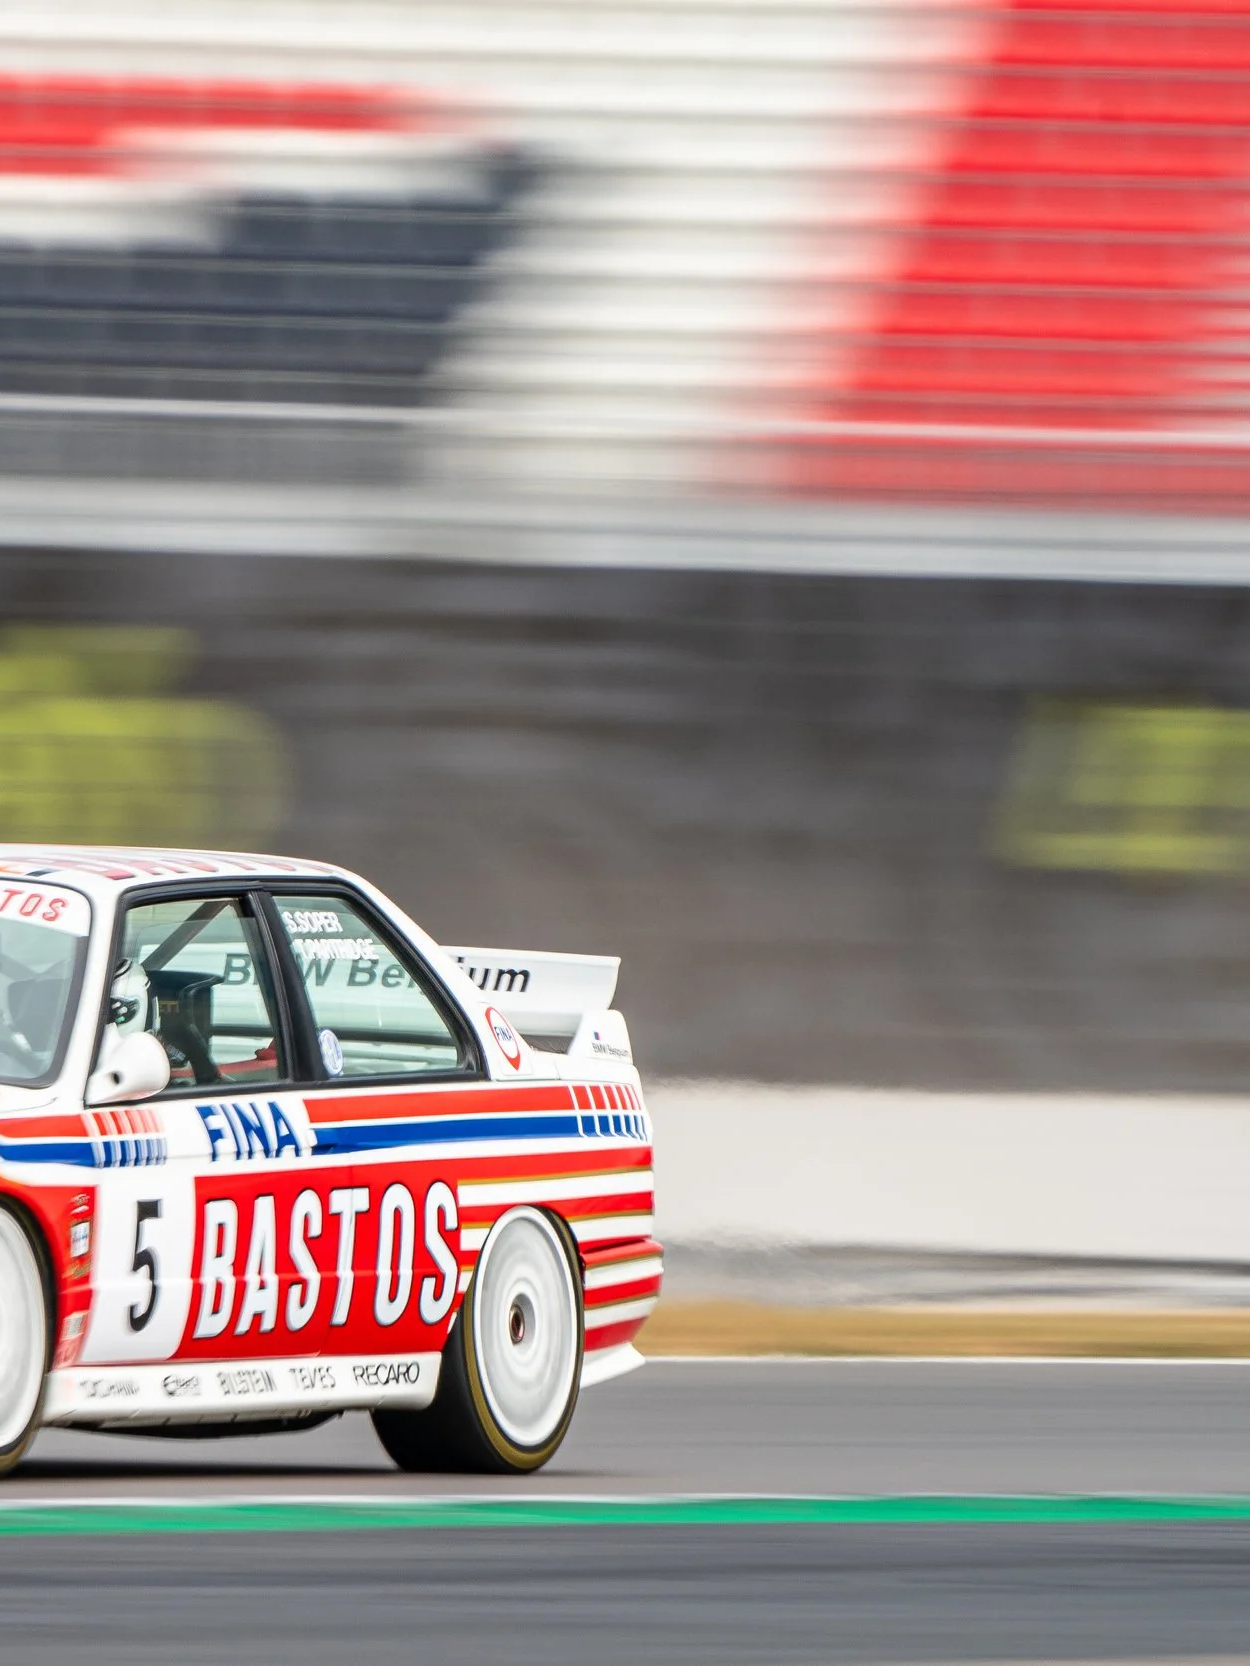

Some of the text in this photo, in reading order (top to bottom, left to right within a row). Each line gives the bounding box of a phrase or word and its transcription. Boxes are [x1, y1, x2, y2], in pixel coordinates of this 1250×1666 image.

[281, 911, 344, 934] S.SOPER
[493, 1026, 513, 1042] FINA
[195, 1100, 302, 1162] FINA
[129, 1199, 163, 1333] 5
[192, 1179, 459, 1340] BASTOS
[287, 1365, 337, 1389] TEVES
[352, 1360, 421, 1387] RECARO
